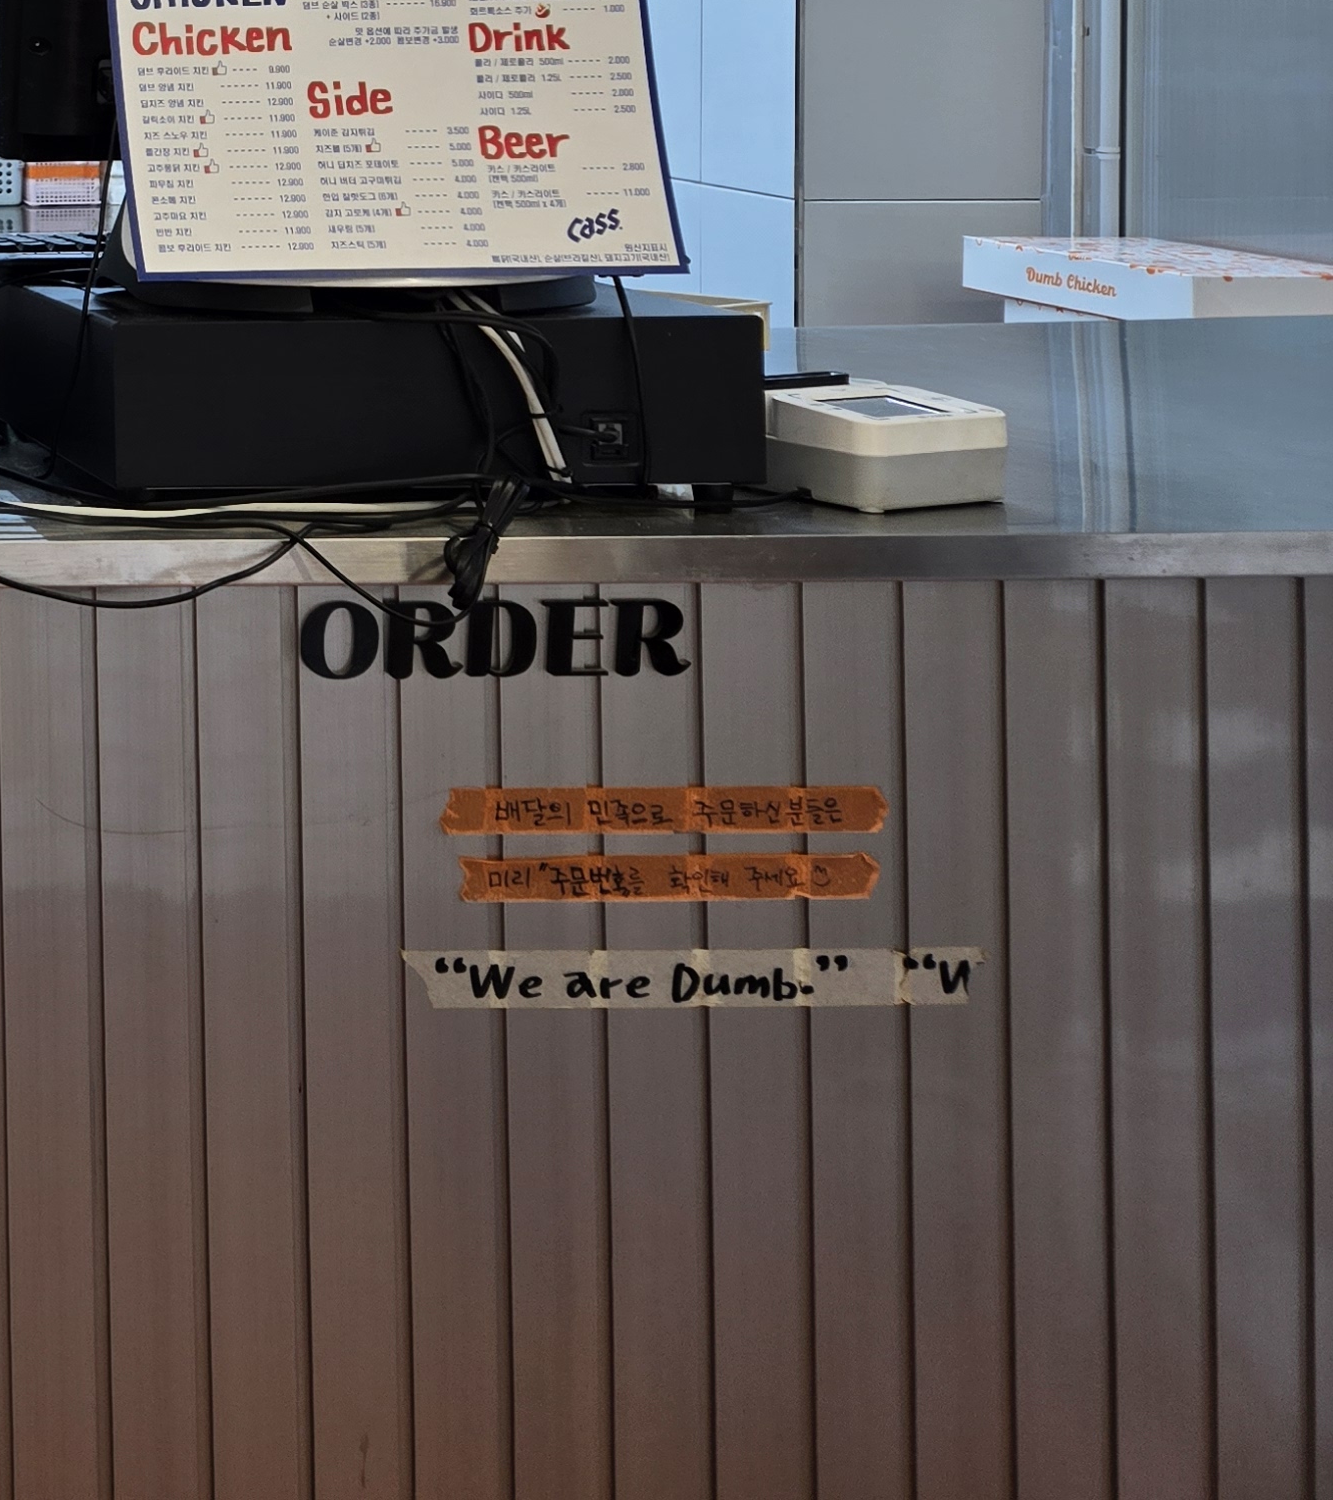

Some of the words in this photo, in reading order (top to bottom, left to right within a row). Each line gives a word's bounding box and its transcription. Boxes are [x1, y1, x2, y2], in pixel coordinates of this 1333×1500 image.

[133, 21, 293, 56] Chicken
[468, 22, 570, 52] Drink
[307, 80, 394, 120] Side
[478, 125, 570, 160] Beer
[1026, 266, 1063, 288] Dumb
[1067, 274, 1117, 298] Chicken
[300, 598, 693, 680] ORDER
[495, 800, 572, 826] 배달의
[588, 800, 674, 826] 민족으로
[566, 971, 651, 999] are
